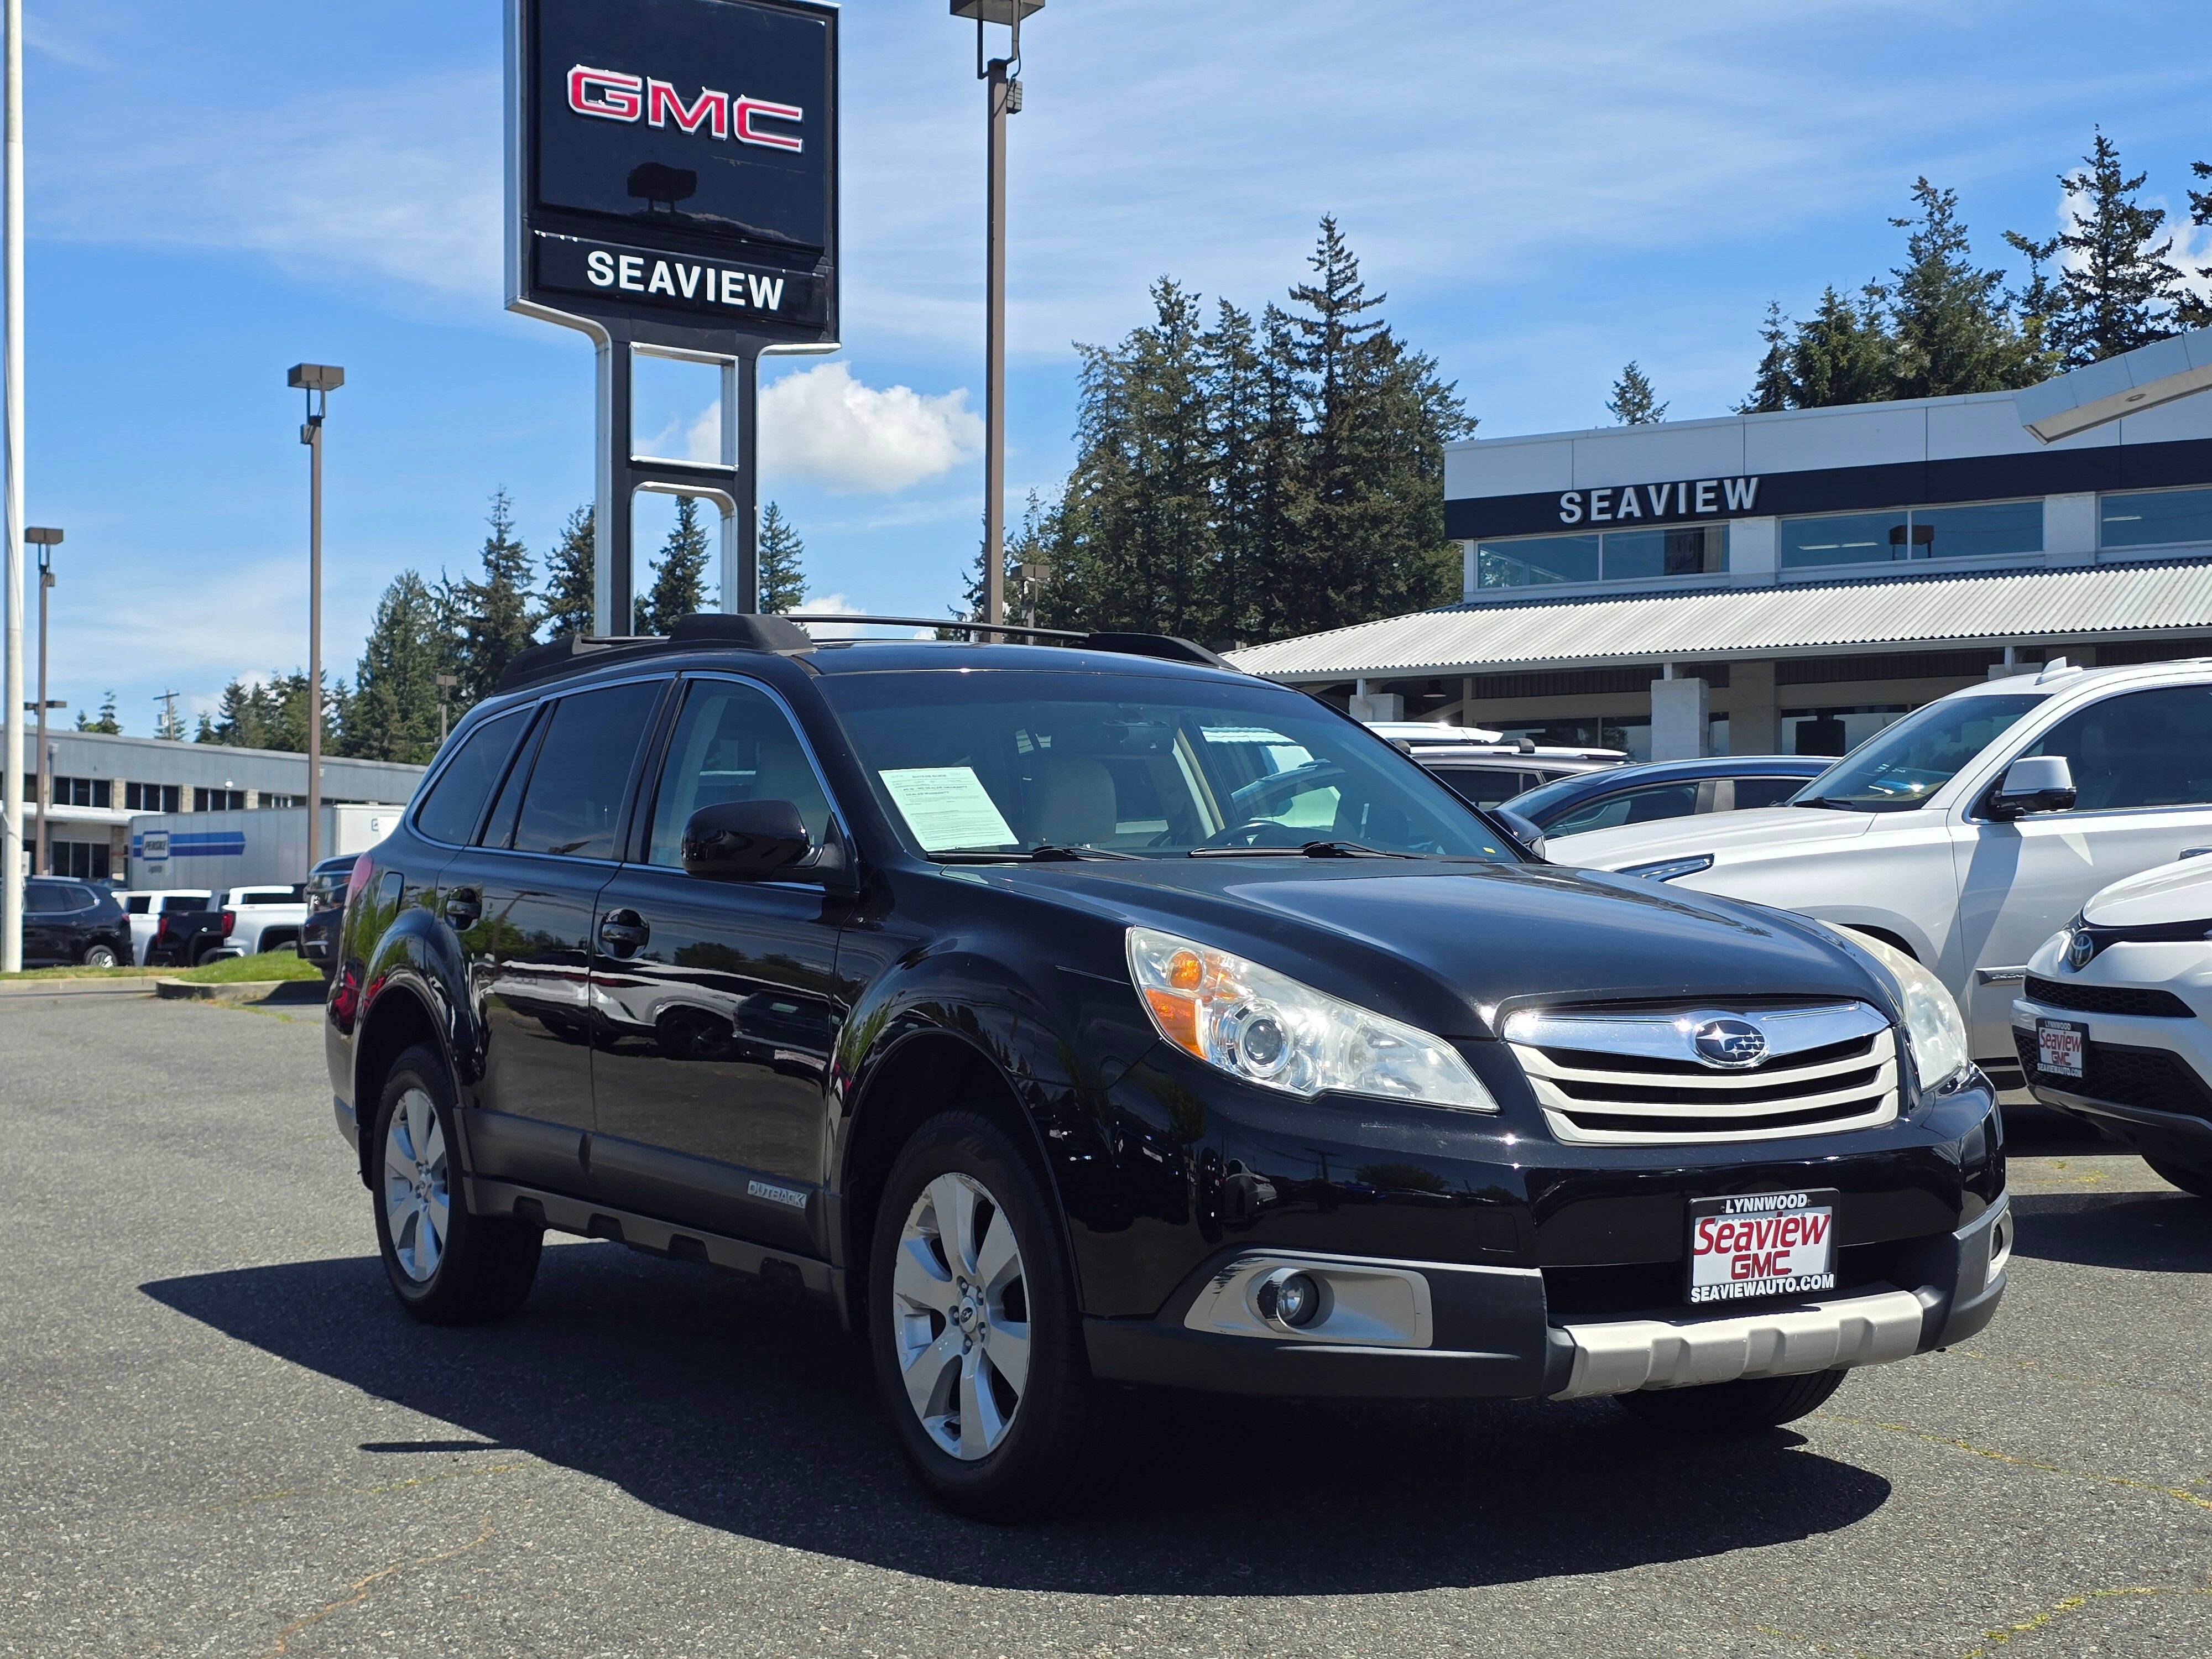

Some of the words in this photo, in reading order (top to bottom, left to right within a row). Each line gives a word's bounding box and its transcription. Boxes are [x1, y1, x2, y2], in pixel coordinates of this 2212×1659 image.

[567, 64, 803, 153] GMC
[587, 251, 784, 311] SEAVIEW
[1559, 477, 1760, 524] SEAVIEW
[2044, 1020, 2072, 1031] LYNNWOOD
[2040, 1029, 2082, 1052] Seaview
[2037, 1063, 2083, 1078] SEAVIEWAUTO.COM
[2051, 1051, 2072, 1066] GMC
[749, 1181, 806, 1208] OUTBACK
[1725, 1193, 1808, 1214] LYNNWOOD
[1693, 1211, 1830, 1255] Seaview
[1731, 1250, 1792, 1280] GMC
[1691, 1273, 1834, 1303] SEAVIEWAUTO.COM
